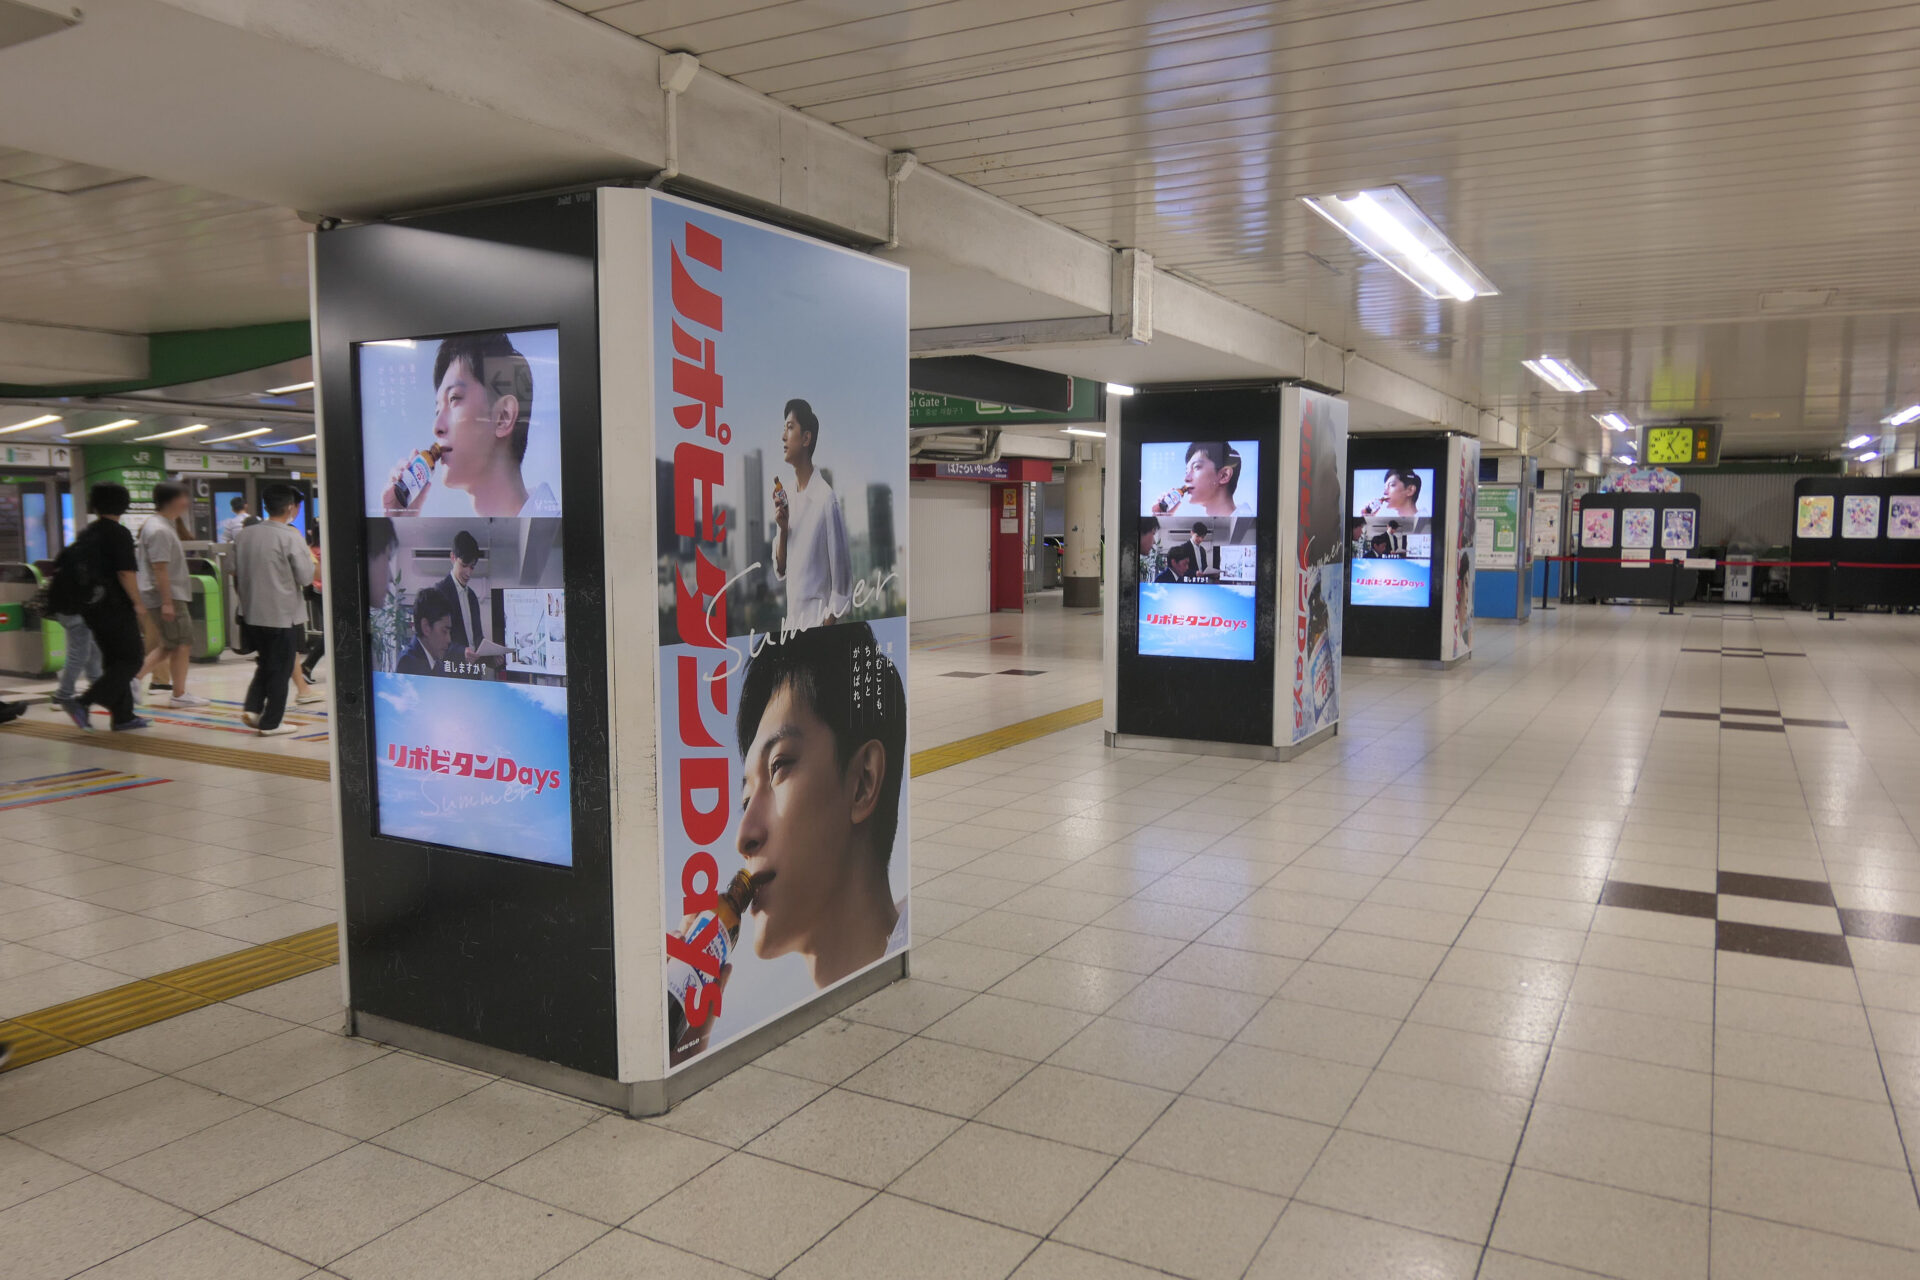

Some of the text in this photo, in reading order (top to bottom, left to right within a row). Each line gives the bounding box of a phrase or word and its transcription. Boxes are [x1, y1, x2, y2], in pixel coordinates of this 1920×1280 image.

[919, 397, 940, 407] Gate
[943, 396, 947, 406] 1
[666, 221, 732, 1028] リポビタンDays
[702, 562, 900, 682] Summer
[1146, 613, 1248, 631] リポビタンDays
[852, 645, 861, 709] がんばれ。
[388, 743, 561, 794] リポビタンDays
[419, 765, 540, 817] Summer
